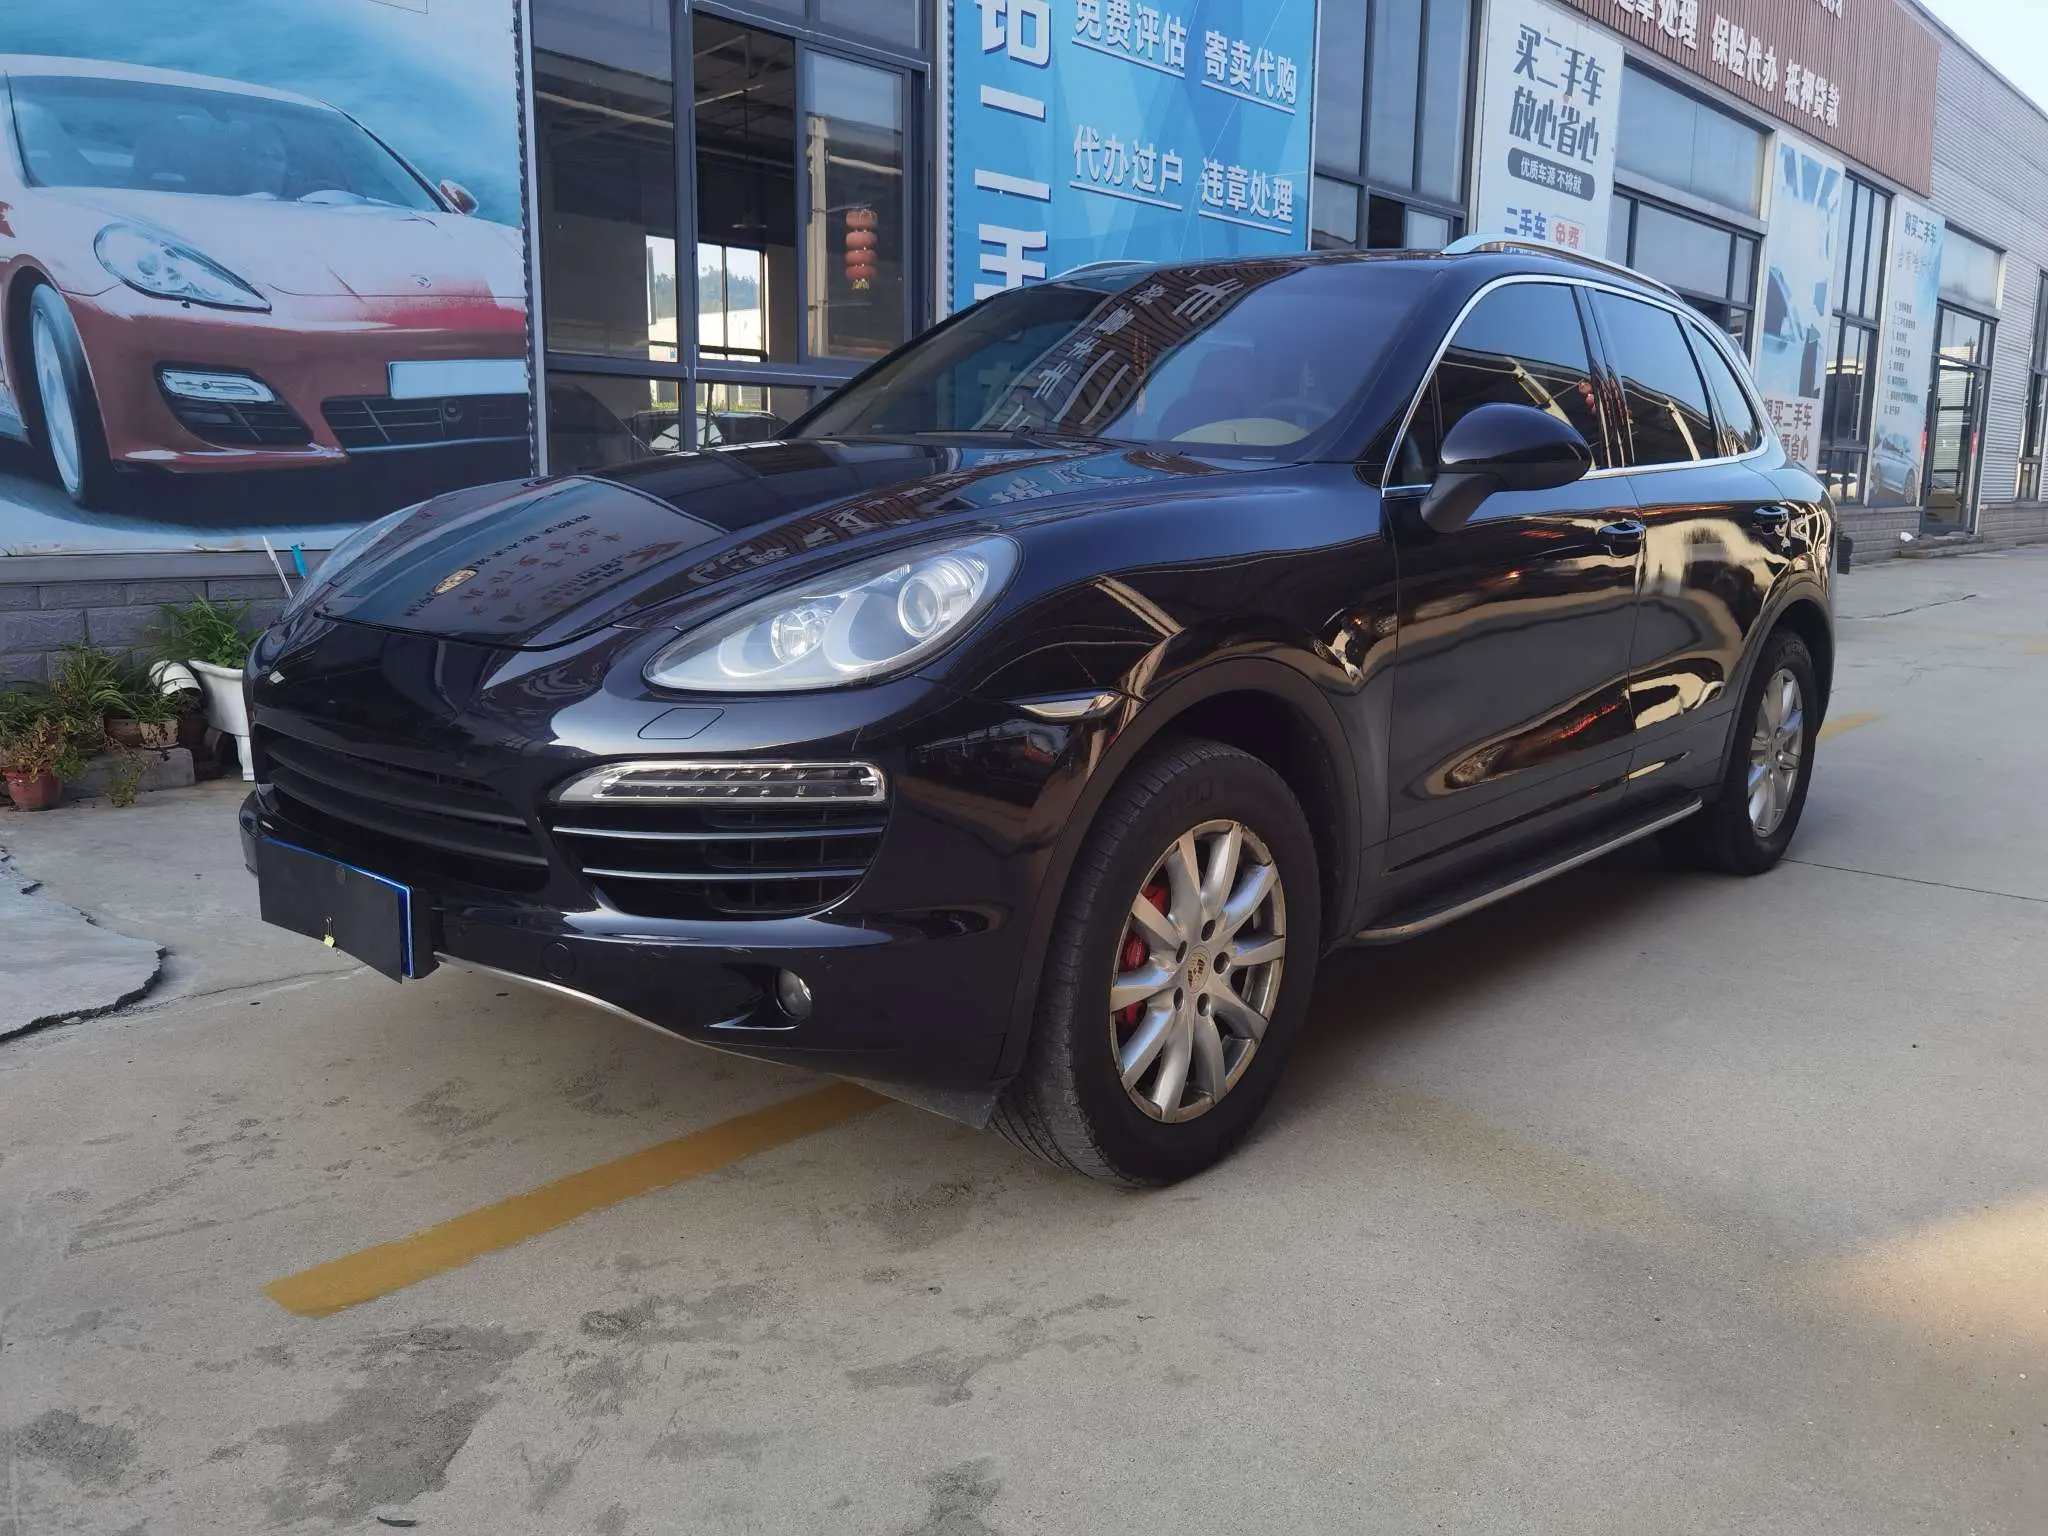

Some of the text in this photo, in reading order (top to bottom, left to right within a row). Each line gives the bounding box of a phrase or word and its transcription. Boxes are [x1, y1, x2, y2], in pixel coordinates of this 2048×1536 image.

[1075, 0, 1187, 69] 免费评估
[1204, 30, 1297, 106] 寄卖代购
[1513, 24, 1605, 106] 买二手车
[1711, 13, 1778, 92] 保险代办
[1784, 59, 1840, 129] 抵押贷款
[1073, 124, 1184, 195] 代办过户
[1509, 86, 1599, 164] 放心省心
[1201, 158, 1294, 223] 违章处理
[1521, 156, 1556, 186] 优质车源
[1504, 207, 1547, 240] 二手车
